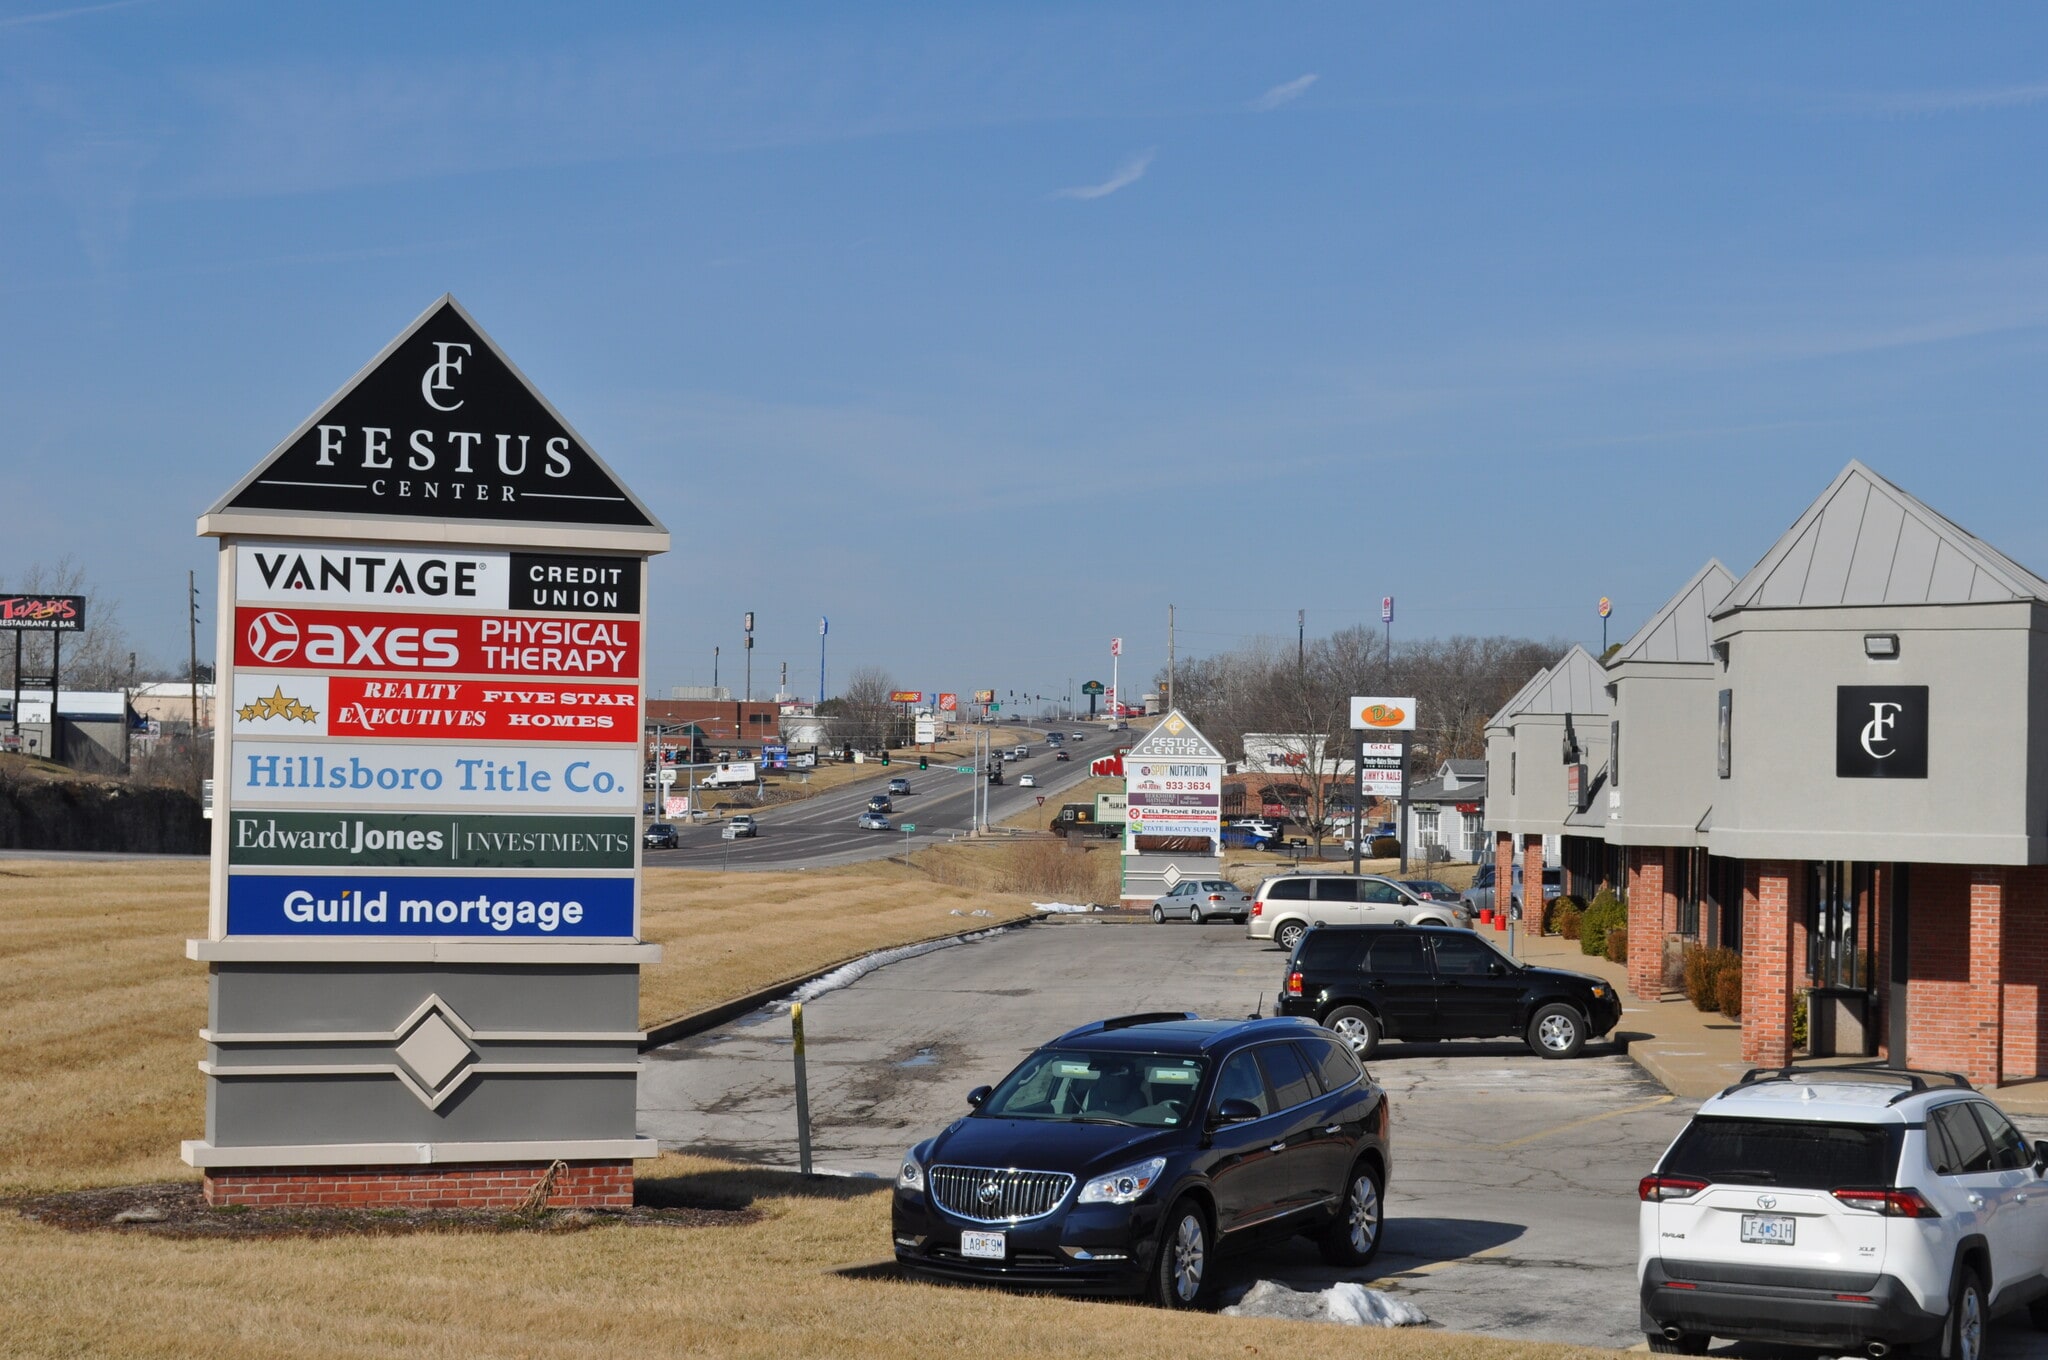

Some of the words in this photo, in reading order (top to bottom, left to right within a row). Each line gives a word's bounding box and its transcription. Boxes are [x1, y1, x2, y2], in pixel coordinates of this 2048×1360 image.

[315, 424, 571, 478] FESTUS
[371, 479, 516, 502] CENTER
[254, 552, 477, 597] VANTAGE
[529, 564, 622, 585] CREDIT
[532, 588, 617, 608] UNION
[59, 620, 76, 628] BAR
[481, 619, 628, 647] PHYSICAL
[481, 645, 627, 673] THERAPY
[363, 682, 462, 700] REALTY
[482, 689, 556, 705] FIVE
[559, 691, 635, 707] STAR
[337, 702, 486, 731] EXECUTIVES
[507, 713, 615, 729] HOMES
[1143, 746, 1207, 755] CENTRE
[1151, 737, 1199, 747] FESTUS
[246, 754, 443, 791] Hillsboro
[455, 758, 551, 793] Title
[564, 761, 625, 794] Co.
[1169, 765, 1208, 777] NUTRITION
[1165, 781, 1211, 790] 933-3634
[235, 819, 348, 850] Edward
[350, 821, 444, 854] Jones
[1165, 825, 1193, 833] BEAUTY
[466, 831, 629, 853] INVESTMENTS
[283, 889, 387, 924] Guild
[399, 895, 583, 932] mortgage
